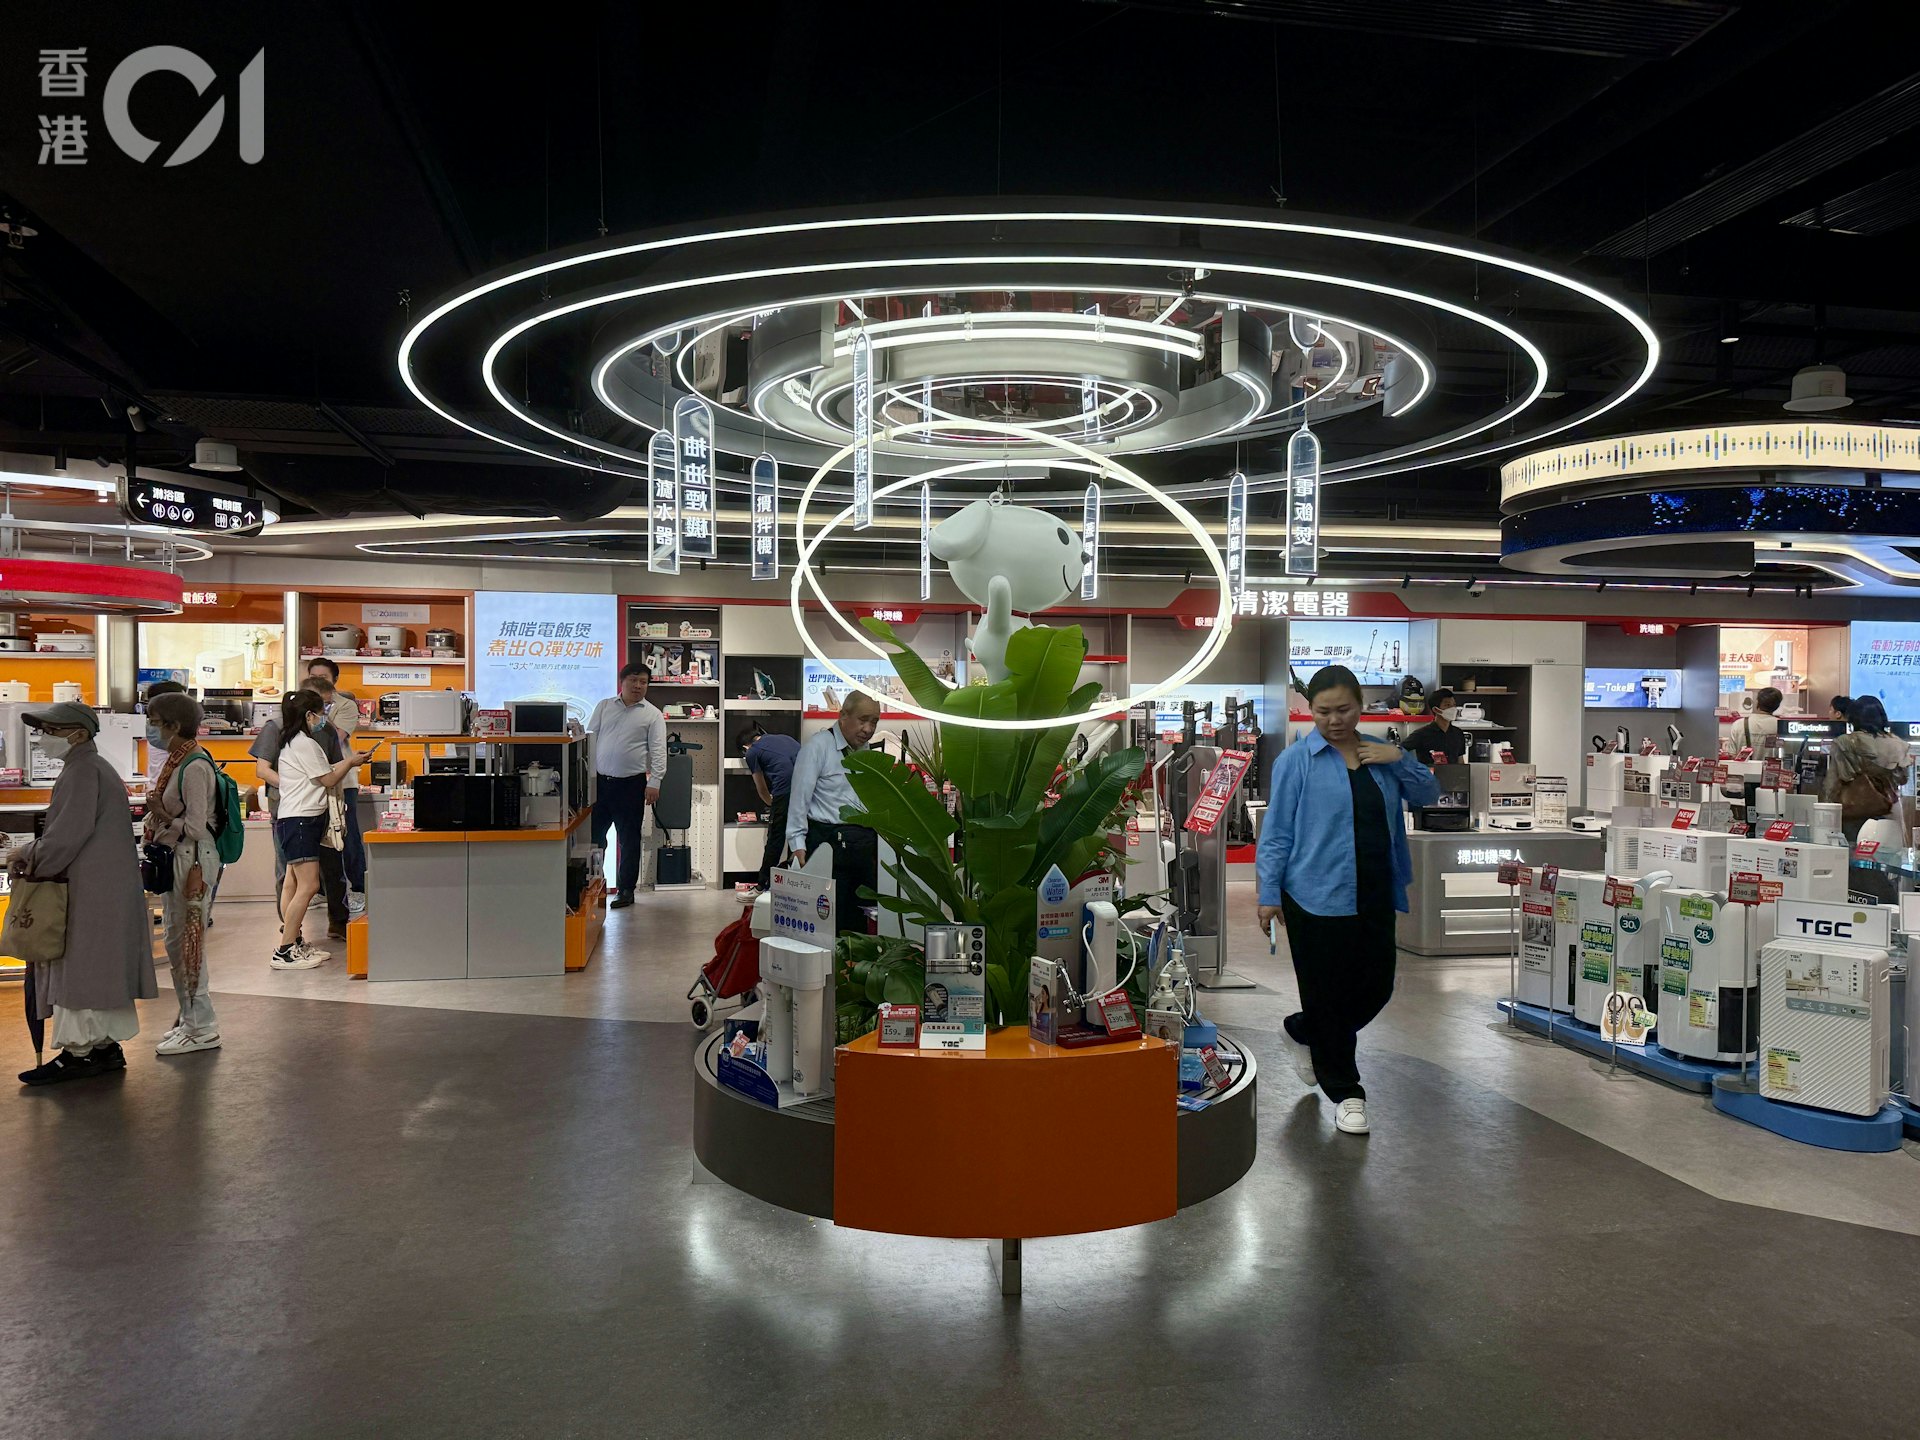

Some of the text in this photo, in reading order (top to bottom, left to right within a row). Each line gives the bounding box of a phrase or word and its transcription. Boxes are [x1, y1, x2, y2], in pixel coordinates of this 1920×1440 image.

[152, 487, 185, 503] 淋浴區
[212, 498, 243, 513] 電競區
[656, 478, 673, 545] 濾水器
[757, 495, 772, 554] 攪拌機
[182, 592, 218, 605] 電飯煲
[1232, 591, 1349, 616] 清潔電器
[499, 621, 592, 638] 揀啱電飯煲
[1640, 624, 1663, 634] 洗地機
[487, 639, 604, 658] 煮出Q彈好味
[1728, 653, 1762, 663] 主人安心
[1798, 723, 1829, 733] Electrolux
[1677, 810, 1694, 820] NEW
[1771, 822, 1790, 830] NEW
[774, 874, 783, 885] 3M
[1046, 887, 1064, 895] Water
[1687, 900, 1707, 911] ThinQ
[1848, 894, 1868, 905] HILCO
[1796, 917, 1852, 939] TGC
